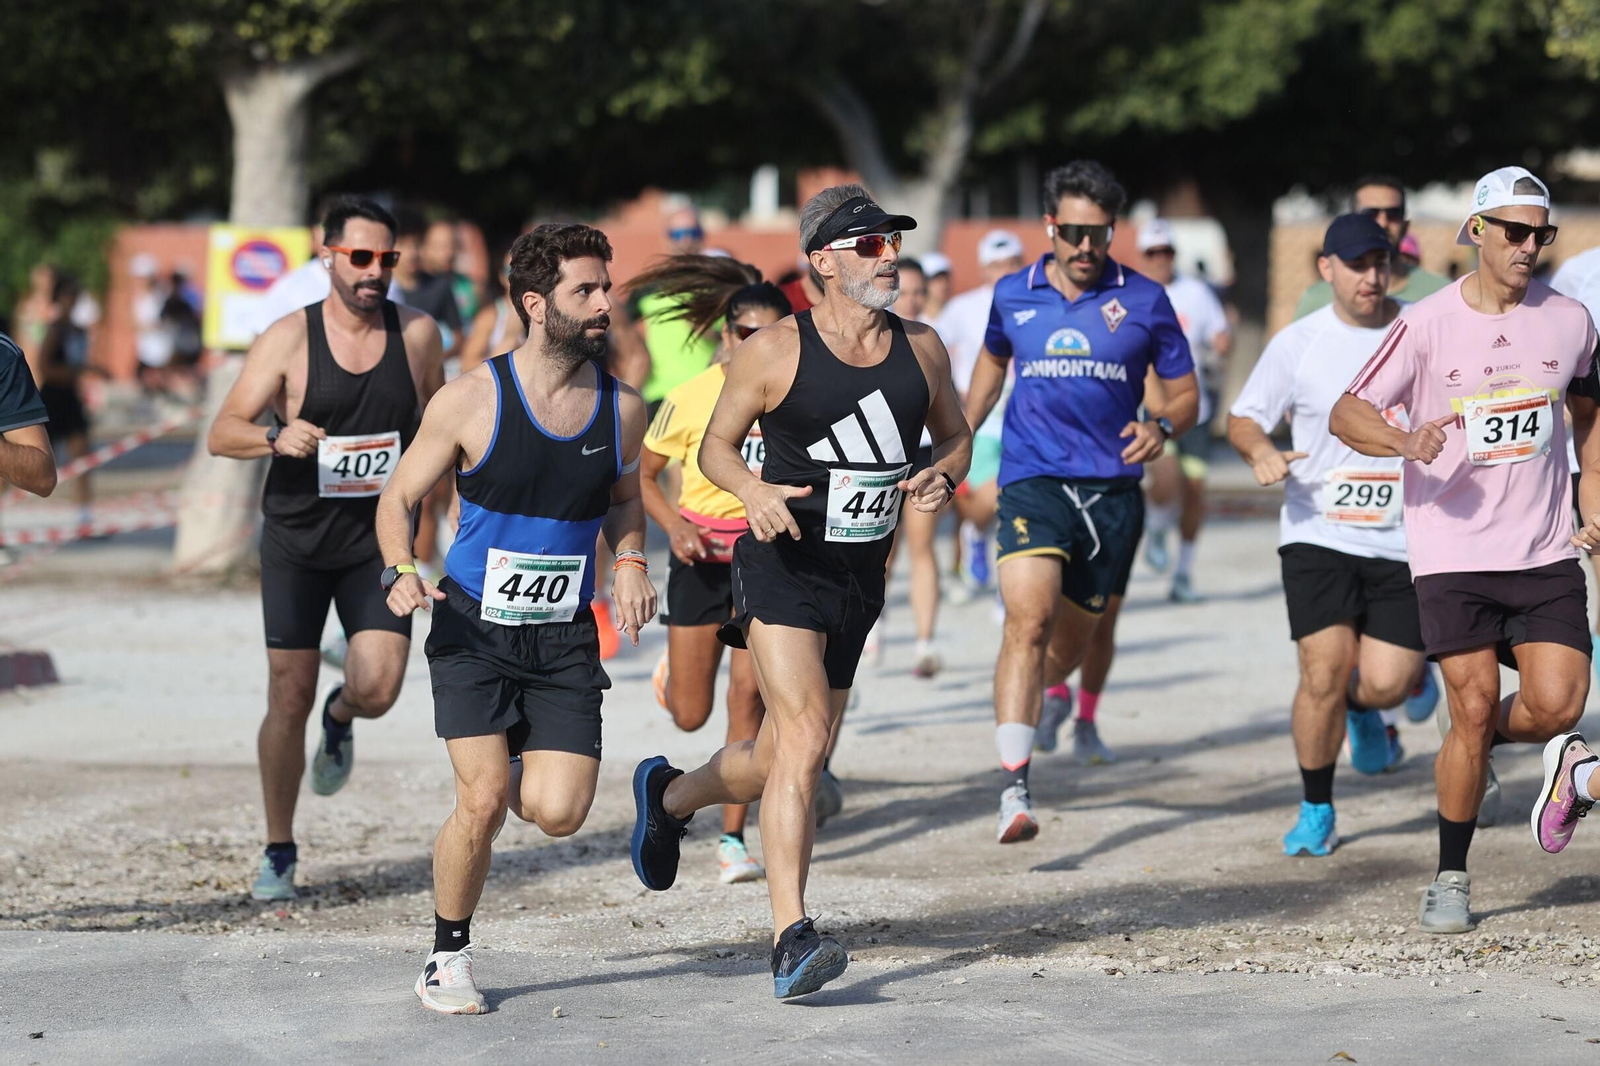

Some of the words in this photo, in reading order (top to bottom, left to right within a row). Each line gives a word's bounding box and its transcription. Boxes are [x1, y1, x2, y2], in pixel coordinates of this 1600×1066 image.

[1496, 364, 1520, 372] ZURICH
[1484, 411, 1540, 444] 314
[332, 451, 389, 478] 402
[842, 487, 898, 519] 442
[1334, 484, 1392, 507] 299
[498, 573, 569, 604] 440
[487, 608, 501, 618] 024
